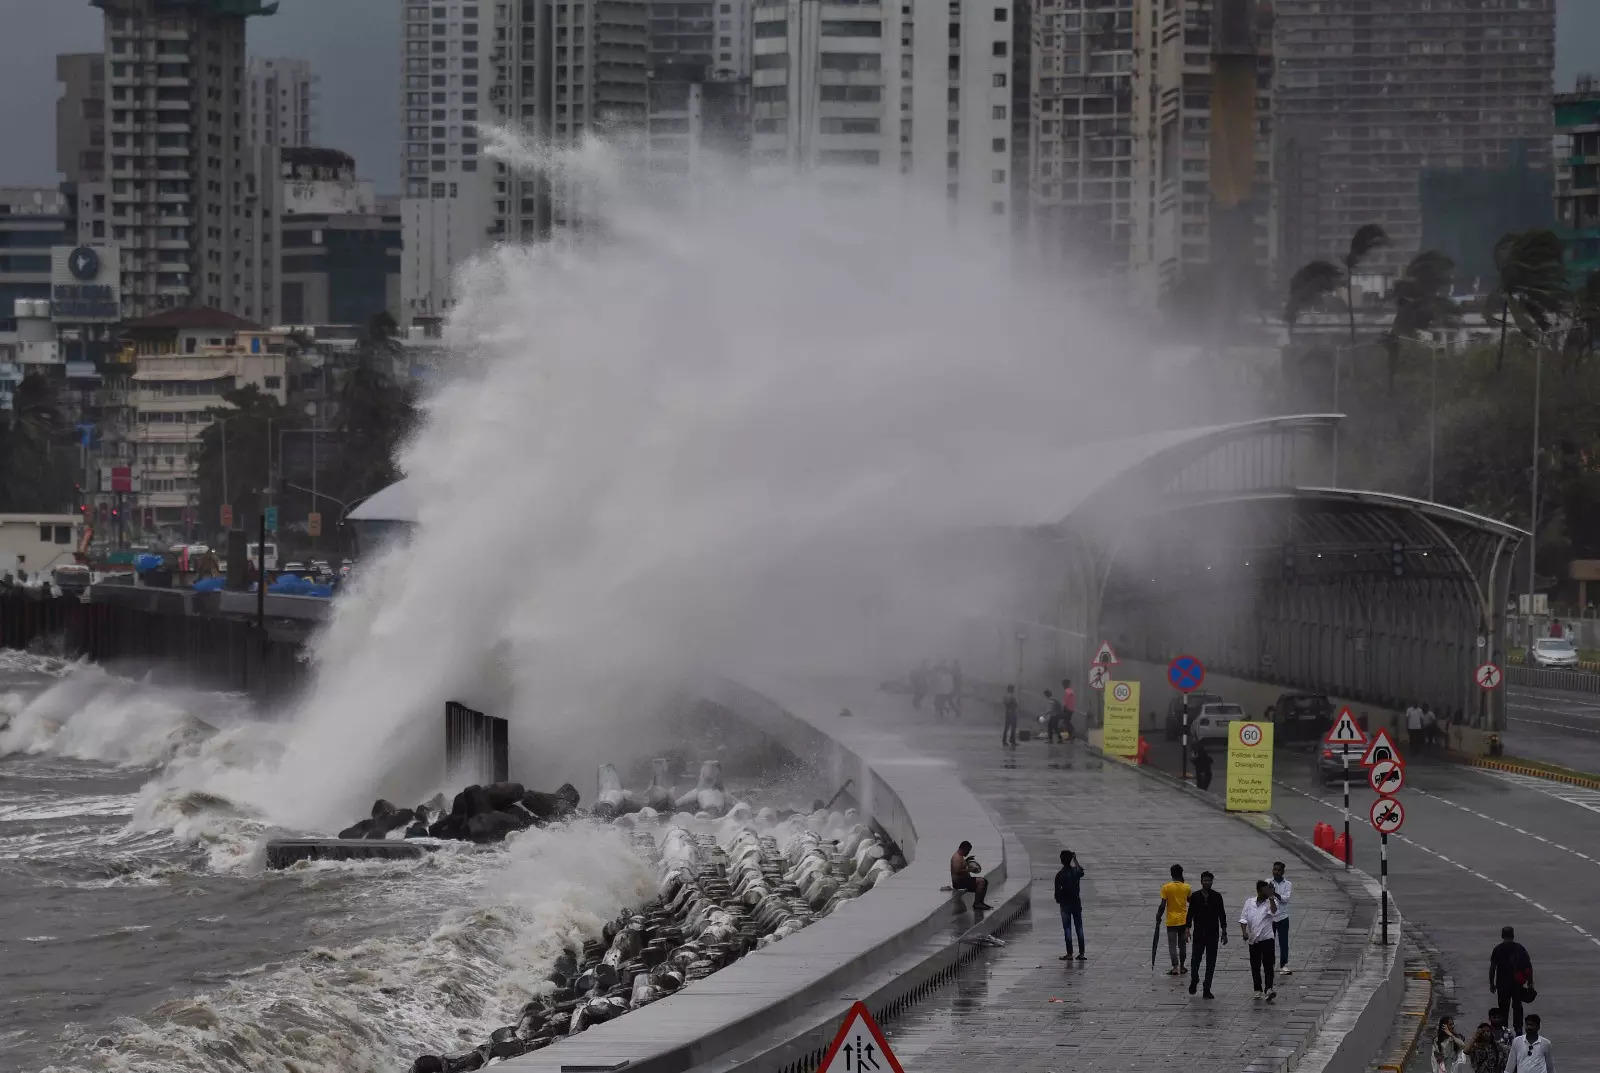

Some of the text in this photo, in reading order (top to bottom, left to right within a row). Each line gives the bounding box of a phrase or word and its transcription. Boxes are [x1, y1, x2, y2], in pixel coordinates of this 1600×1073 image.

[1117, 687, 1128, 697] 60
[1244, 730, 1258, 741] 60
[1231, 751, 1252, 759] Follow
[1238, 776, 1262, 785] You Are
